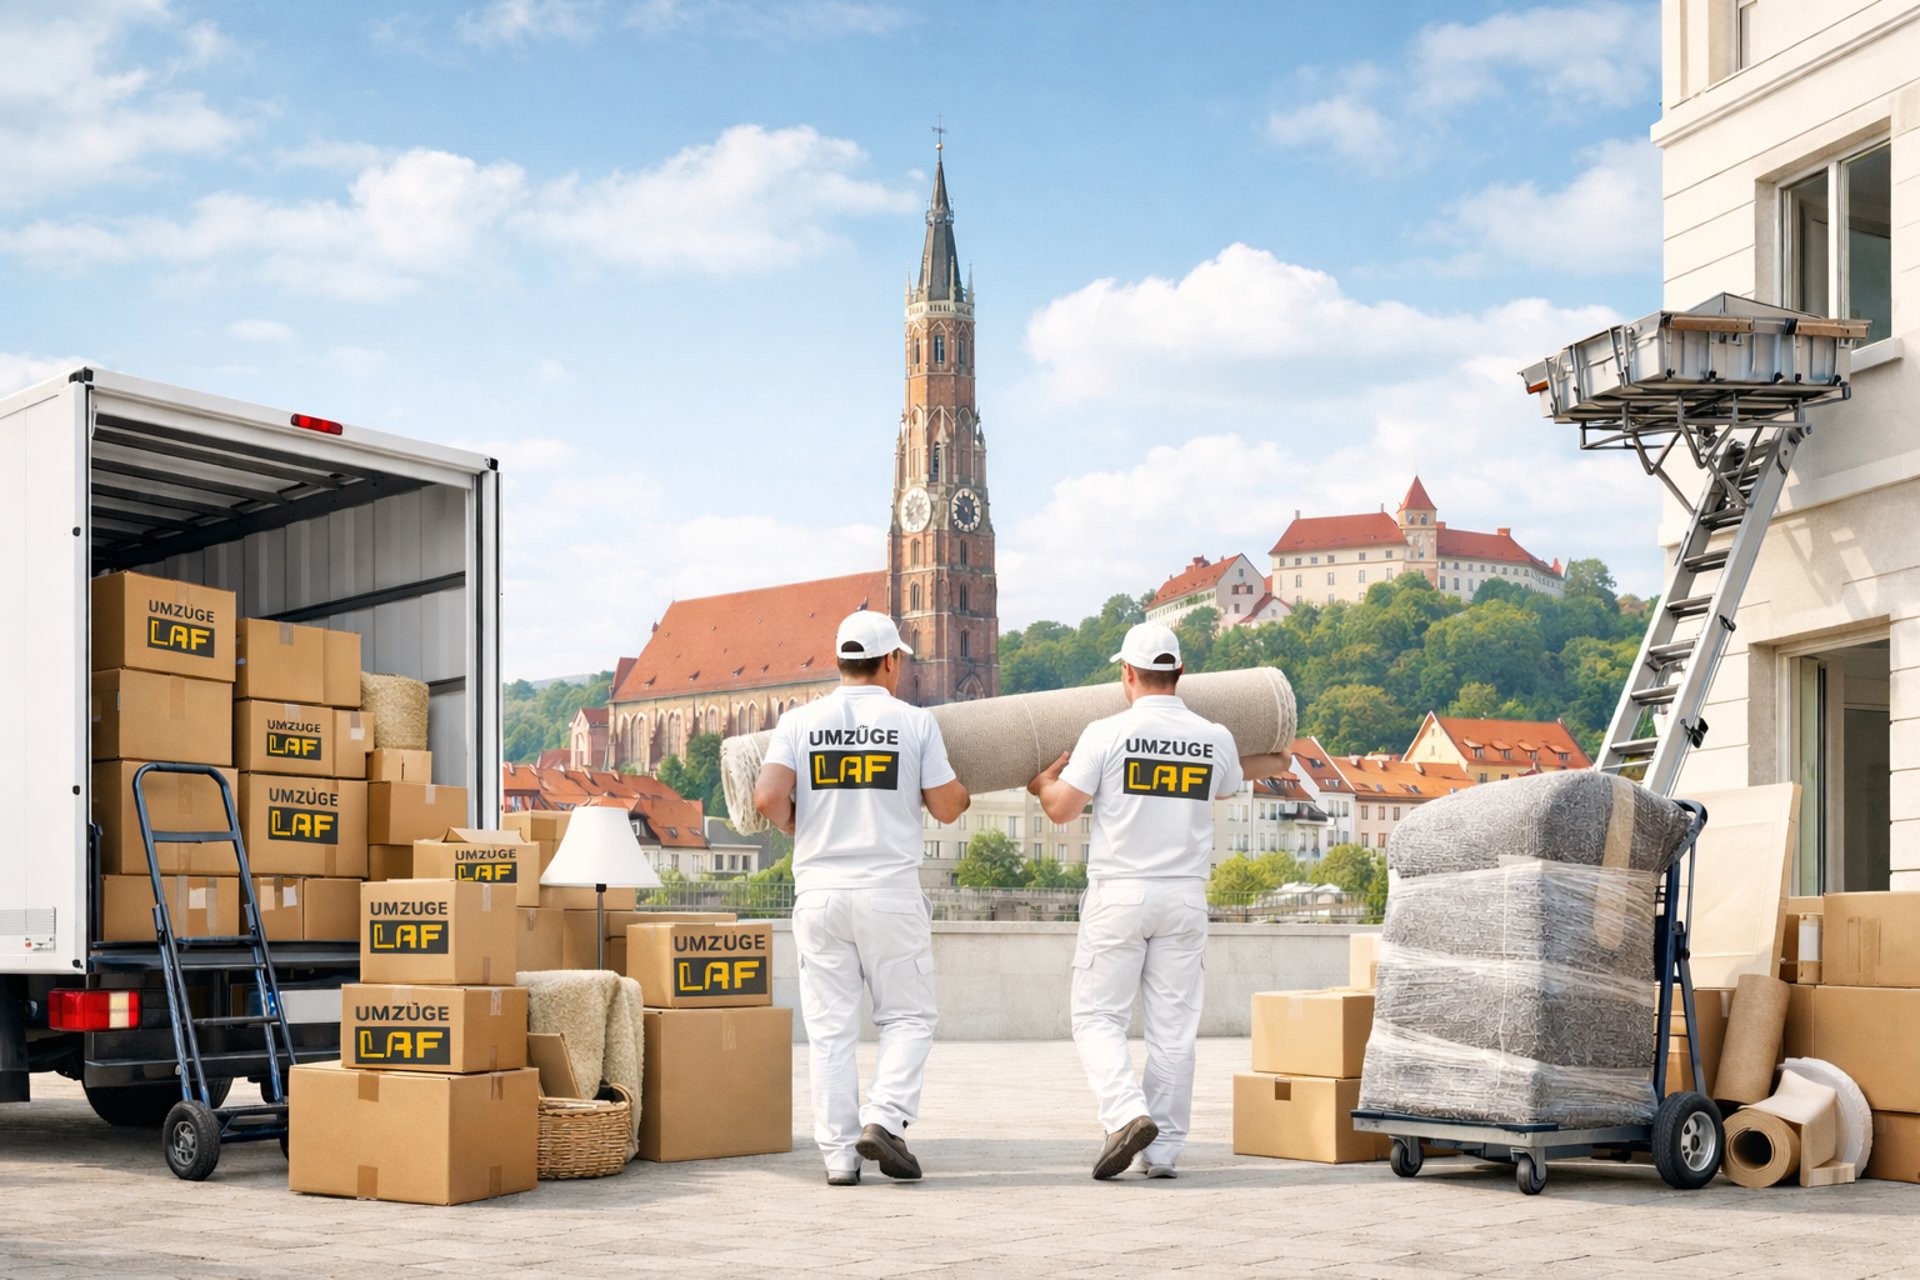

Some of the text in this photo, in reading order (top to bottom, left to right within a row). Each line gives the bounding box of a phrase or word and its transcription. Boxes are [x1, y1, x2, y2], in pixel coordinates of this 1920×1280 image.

[151, 620, 210, 650] LAF
[270, 734, 317, 756] LAF
[815, 755, 892, 784] LAF
[1128, 762, 1208, 792] LAF
[272, 810, 334, 838] LAF
[458, 864, 512, 881] LAF
[374, 923, 442, 949] LAF
[679, 960, 759, 990] LAF
[360, 1030, 443, 1058] LAF
